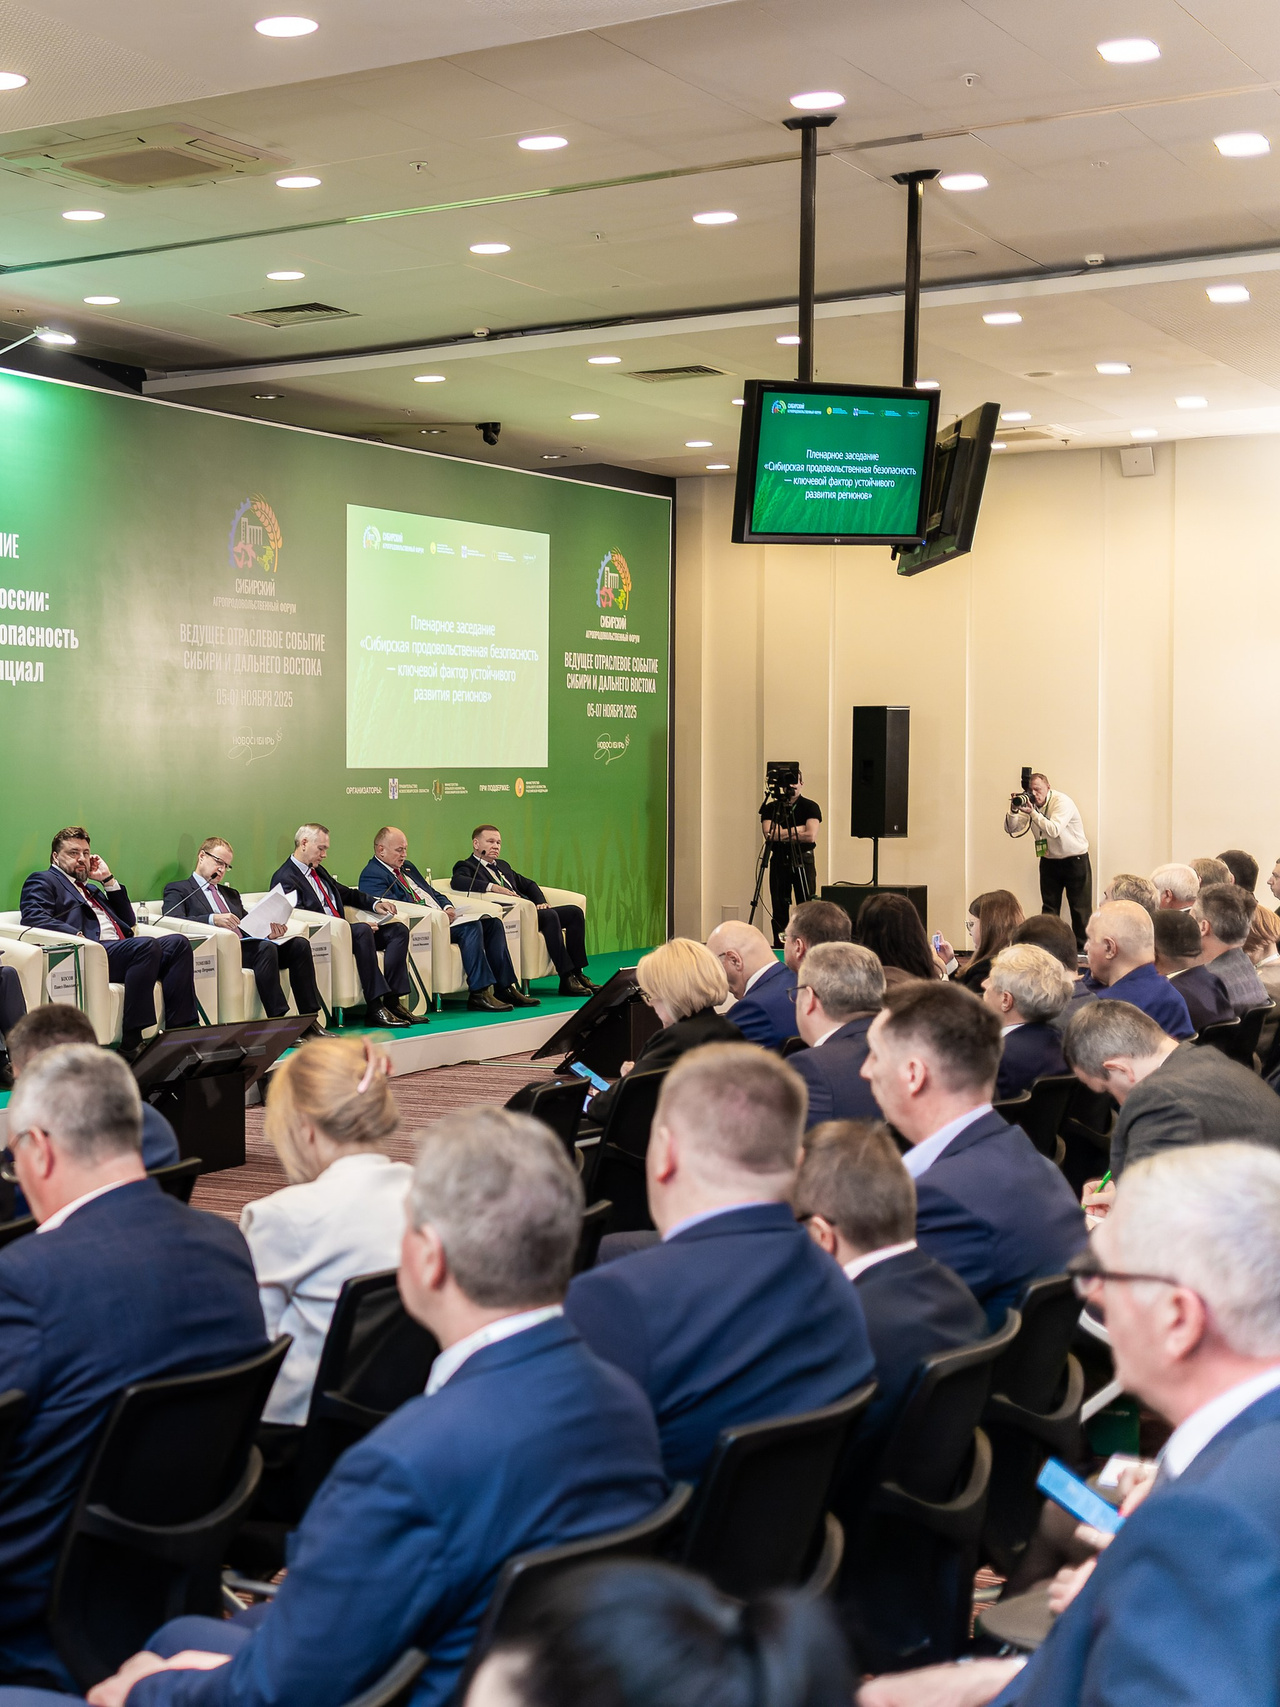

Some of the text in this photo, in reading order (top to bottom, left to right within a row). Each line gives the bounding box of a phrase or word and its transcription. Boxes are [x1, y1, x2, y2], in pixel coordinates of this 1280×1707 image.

[806, 449, 879, 463] Пленарное заседание
[764, 461, 917, 476] «Сибирская продовольственная безопасность
[793, 476, 827, 487] ключевой
[828, 477, 853, 489] фактор
[854, 477, 895, 488] устойчивого
[805, 491, 873, 502] развития регионов»
[235, 578, 276, 597] СИБИРСКИЙ
[212, 597, 297, 614] АГРОПРОДОВОЛЬСТВЕННЫЙ ФОРУМ
[410, 614, 496, 637] Пленарное заседание
[600, 615, 627, 629] СИБИРСКИЙ
[180, 624, 326, 652] ВЕДУЩЕЕ ОТРАСЛЕВОЕ СОБЫТИЕ
[360, 635, 539, 662] «Сибирская продовольственная безопасность
[183, 650, 323, 676] СИБИРИ И ДАЛЬНЕГО ВОСТОКА
[397, 661, 438, 678] ключевой
[439, 662, 469, 682] фактор
[470, 664, 517, 683] устойчивого
[564, 652, 659, 673] ВЕДУЩЕЕ ОТРАСЛЕВОЕ СОБЫТИЕ
[566, 673, 657, 693] СИБИРИ И ДАЛЬНЕГО ВОСТОКА
[216, 688, 293, 707] 05-07 НОЯБРЯ 2025
[414, 688, 493, 705] развития регионов»
[586, 703, 638, 718] 05-07 НОЯБРЯ 2025
